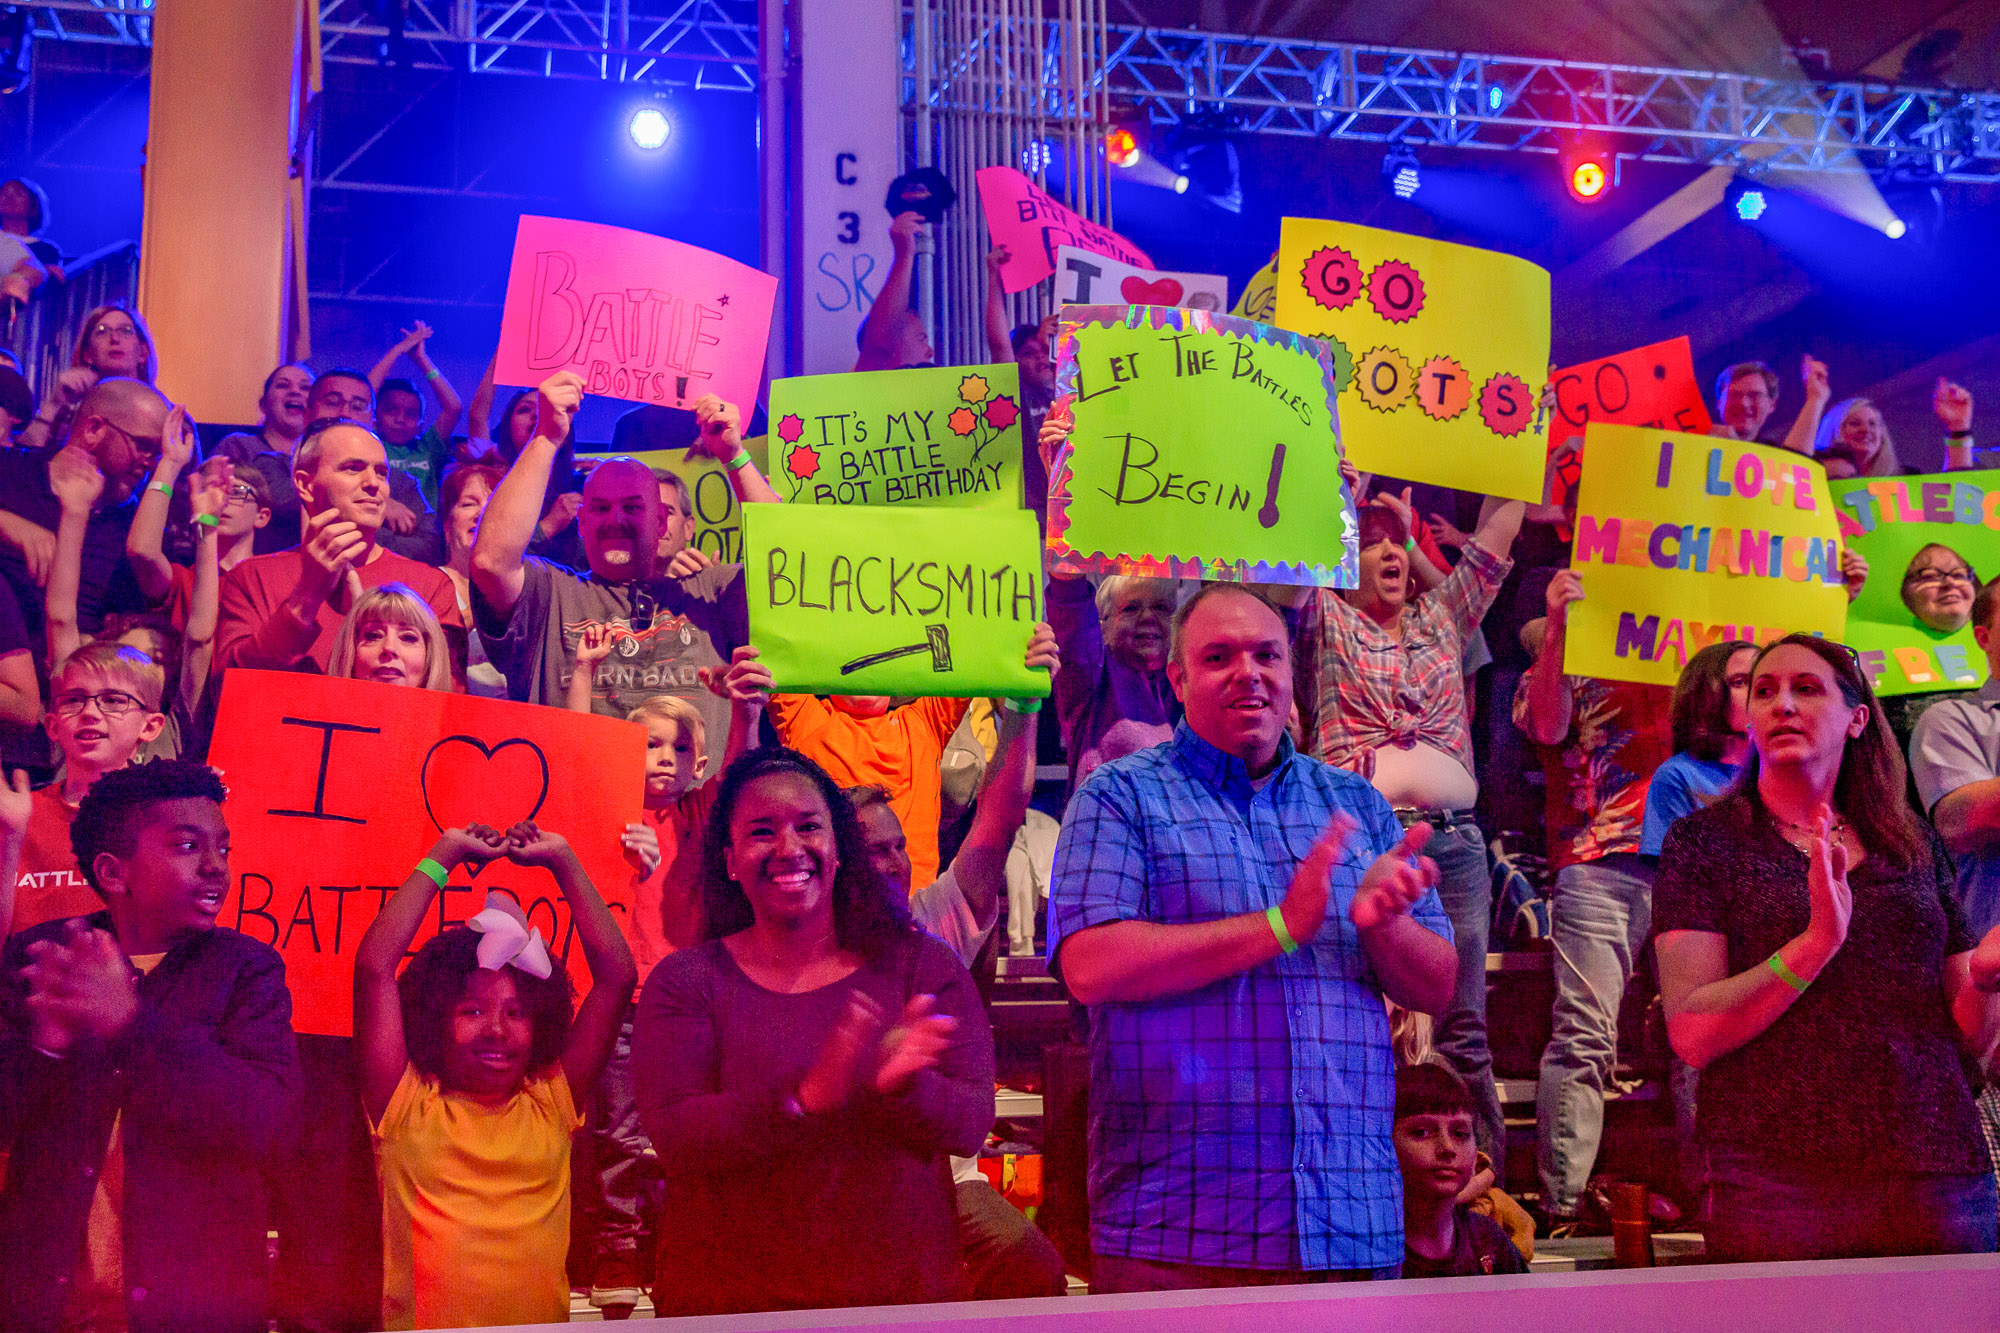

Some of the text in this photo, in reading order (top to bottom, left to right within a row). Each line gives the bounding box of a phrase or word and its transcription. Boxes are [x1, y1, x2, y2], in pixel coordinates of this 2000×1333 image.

[836, 153, 857, 185] C
[838, 212, 860, 244] 3
[816, 252, 874, 312] SR
[1320, 259, 1414, 310] GO
[527, 251, 724, 380] BATTLE
[586, 360, 688, 407] BOTS!
[1158, 334, 1218, 377] THE
[1229, 342, 1312, 426] BATTLES
[1555, 363, 1629, 428] GO
[885, 410, 934, 444] MY
[814, 462, 1003, 505] BOT BIRTHDAY
[840, 444, 945, 480] BATTLE
[1656, 441, 1674, 488] I
[1706, 448, 1817, 511] LOVE
[1575, 515, 1848, 584] MECHANICAL
[768, 547, 1036, 622] BLACKSMITH
[267, 716, 381, 825] I
[14, 870, 88, 888] ATTL
